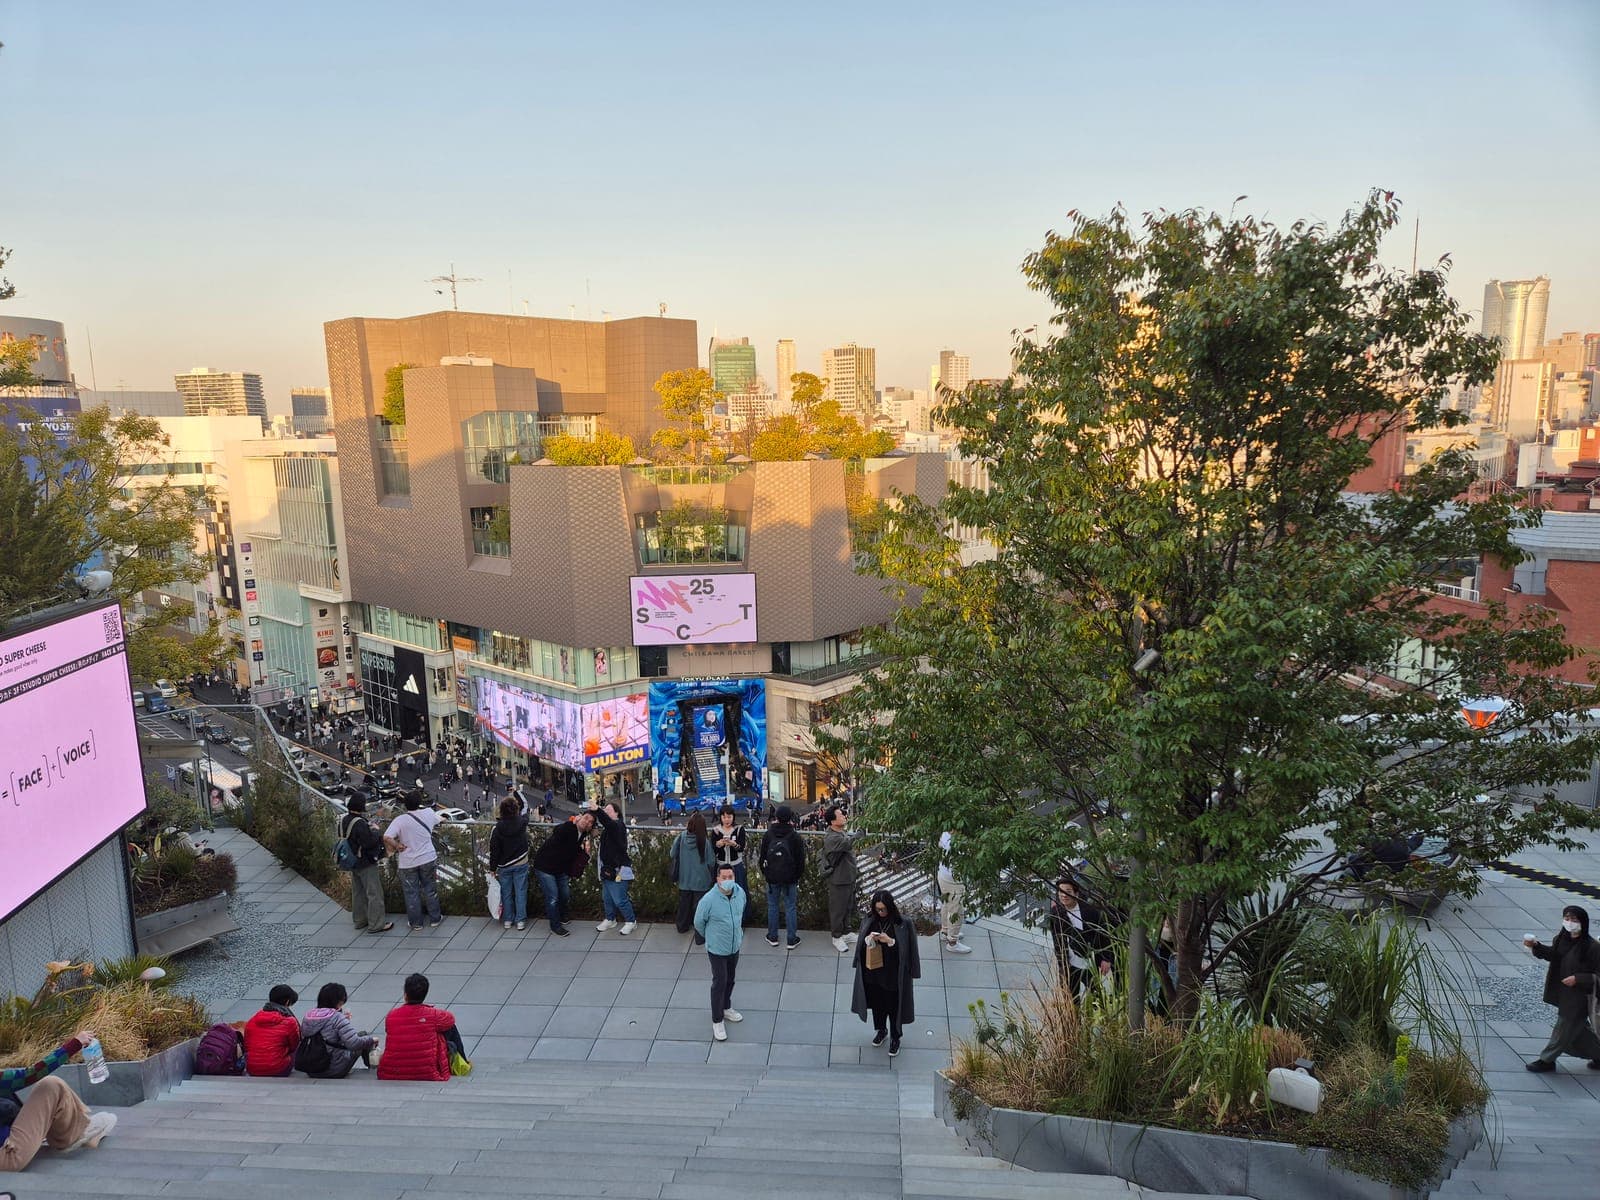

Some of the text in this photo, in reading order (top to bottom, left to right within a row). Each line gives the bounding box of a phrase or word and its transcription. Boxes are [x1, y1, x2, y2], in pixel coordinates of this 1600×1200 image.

[690, 578, 715, 595] 25
[636, 607, 650, 624] S
[738, 604, 752, 620] T
[676, 624, 691, 640] C
[4, 649, 25, 664] SUPER
[25, 641, 47, 656] CHEESE
[591, 748, 644, 769] DULTON
